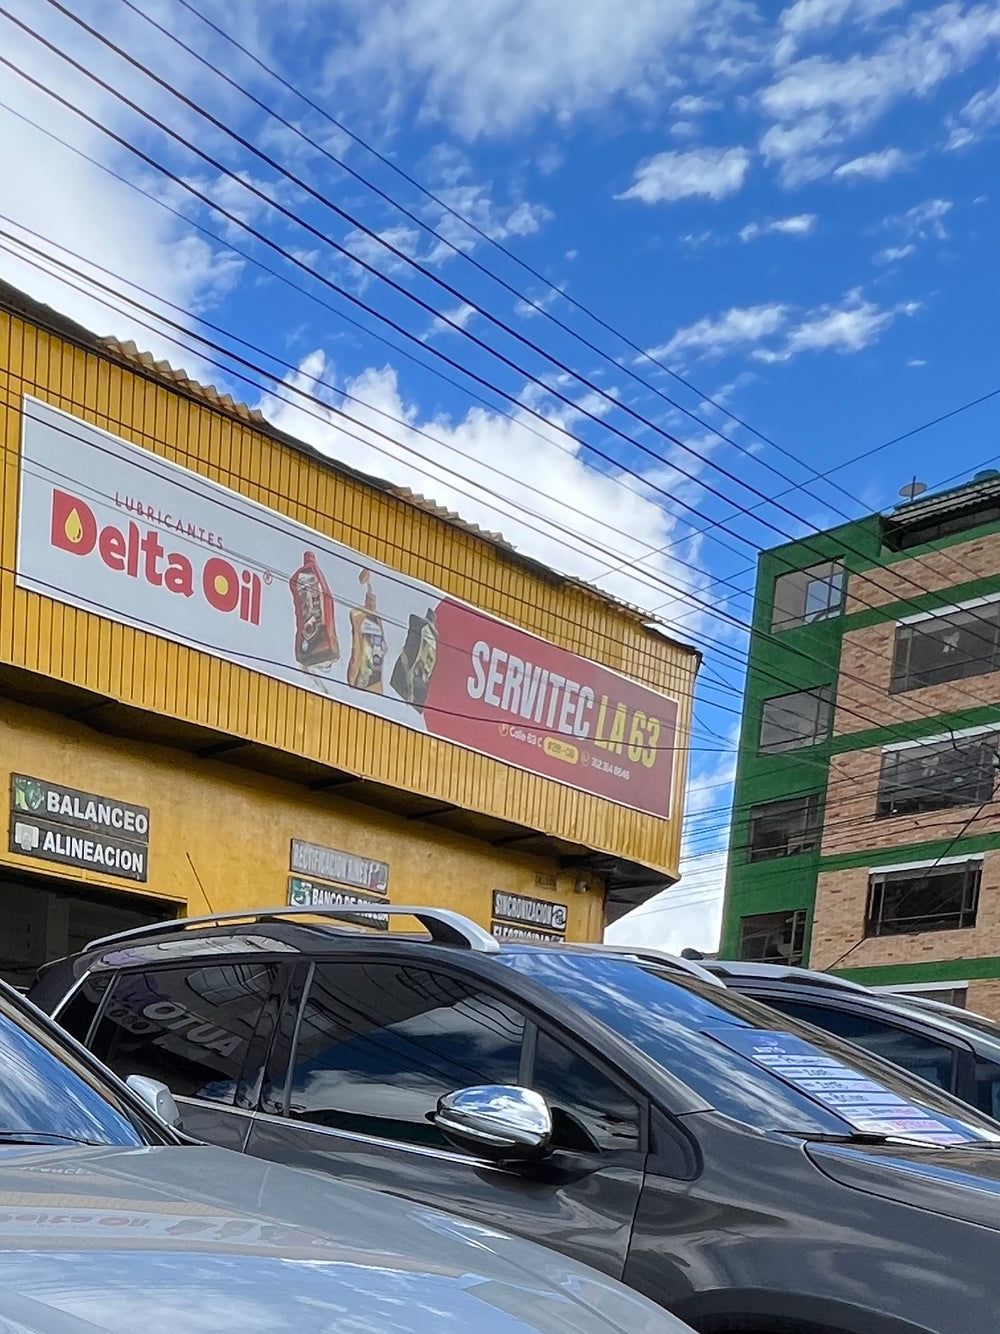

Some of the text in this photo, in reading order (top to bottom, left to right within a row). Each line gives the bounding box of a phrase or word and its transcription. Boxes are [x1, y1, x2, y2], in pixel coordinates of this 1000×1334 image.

[51, 488, 194, 598] Delta
[115, 491, 224, 550] LUBRICANTES
[467, 640, 661, 768] SERVITEC LA 63
[47, 791, 148, 834] BALANCEO
[42, 831, 143, 873] ALINEACION
